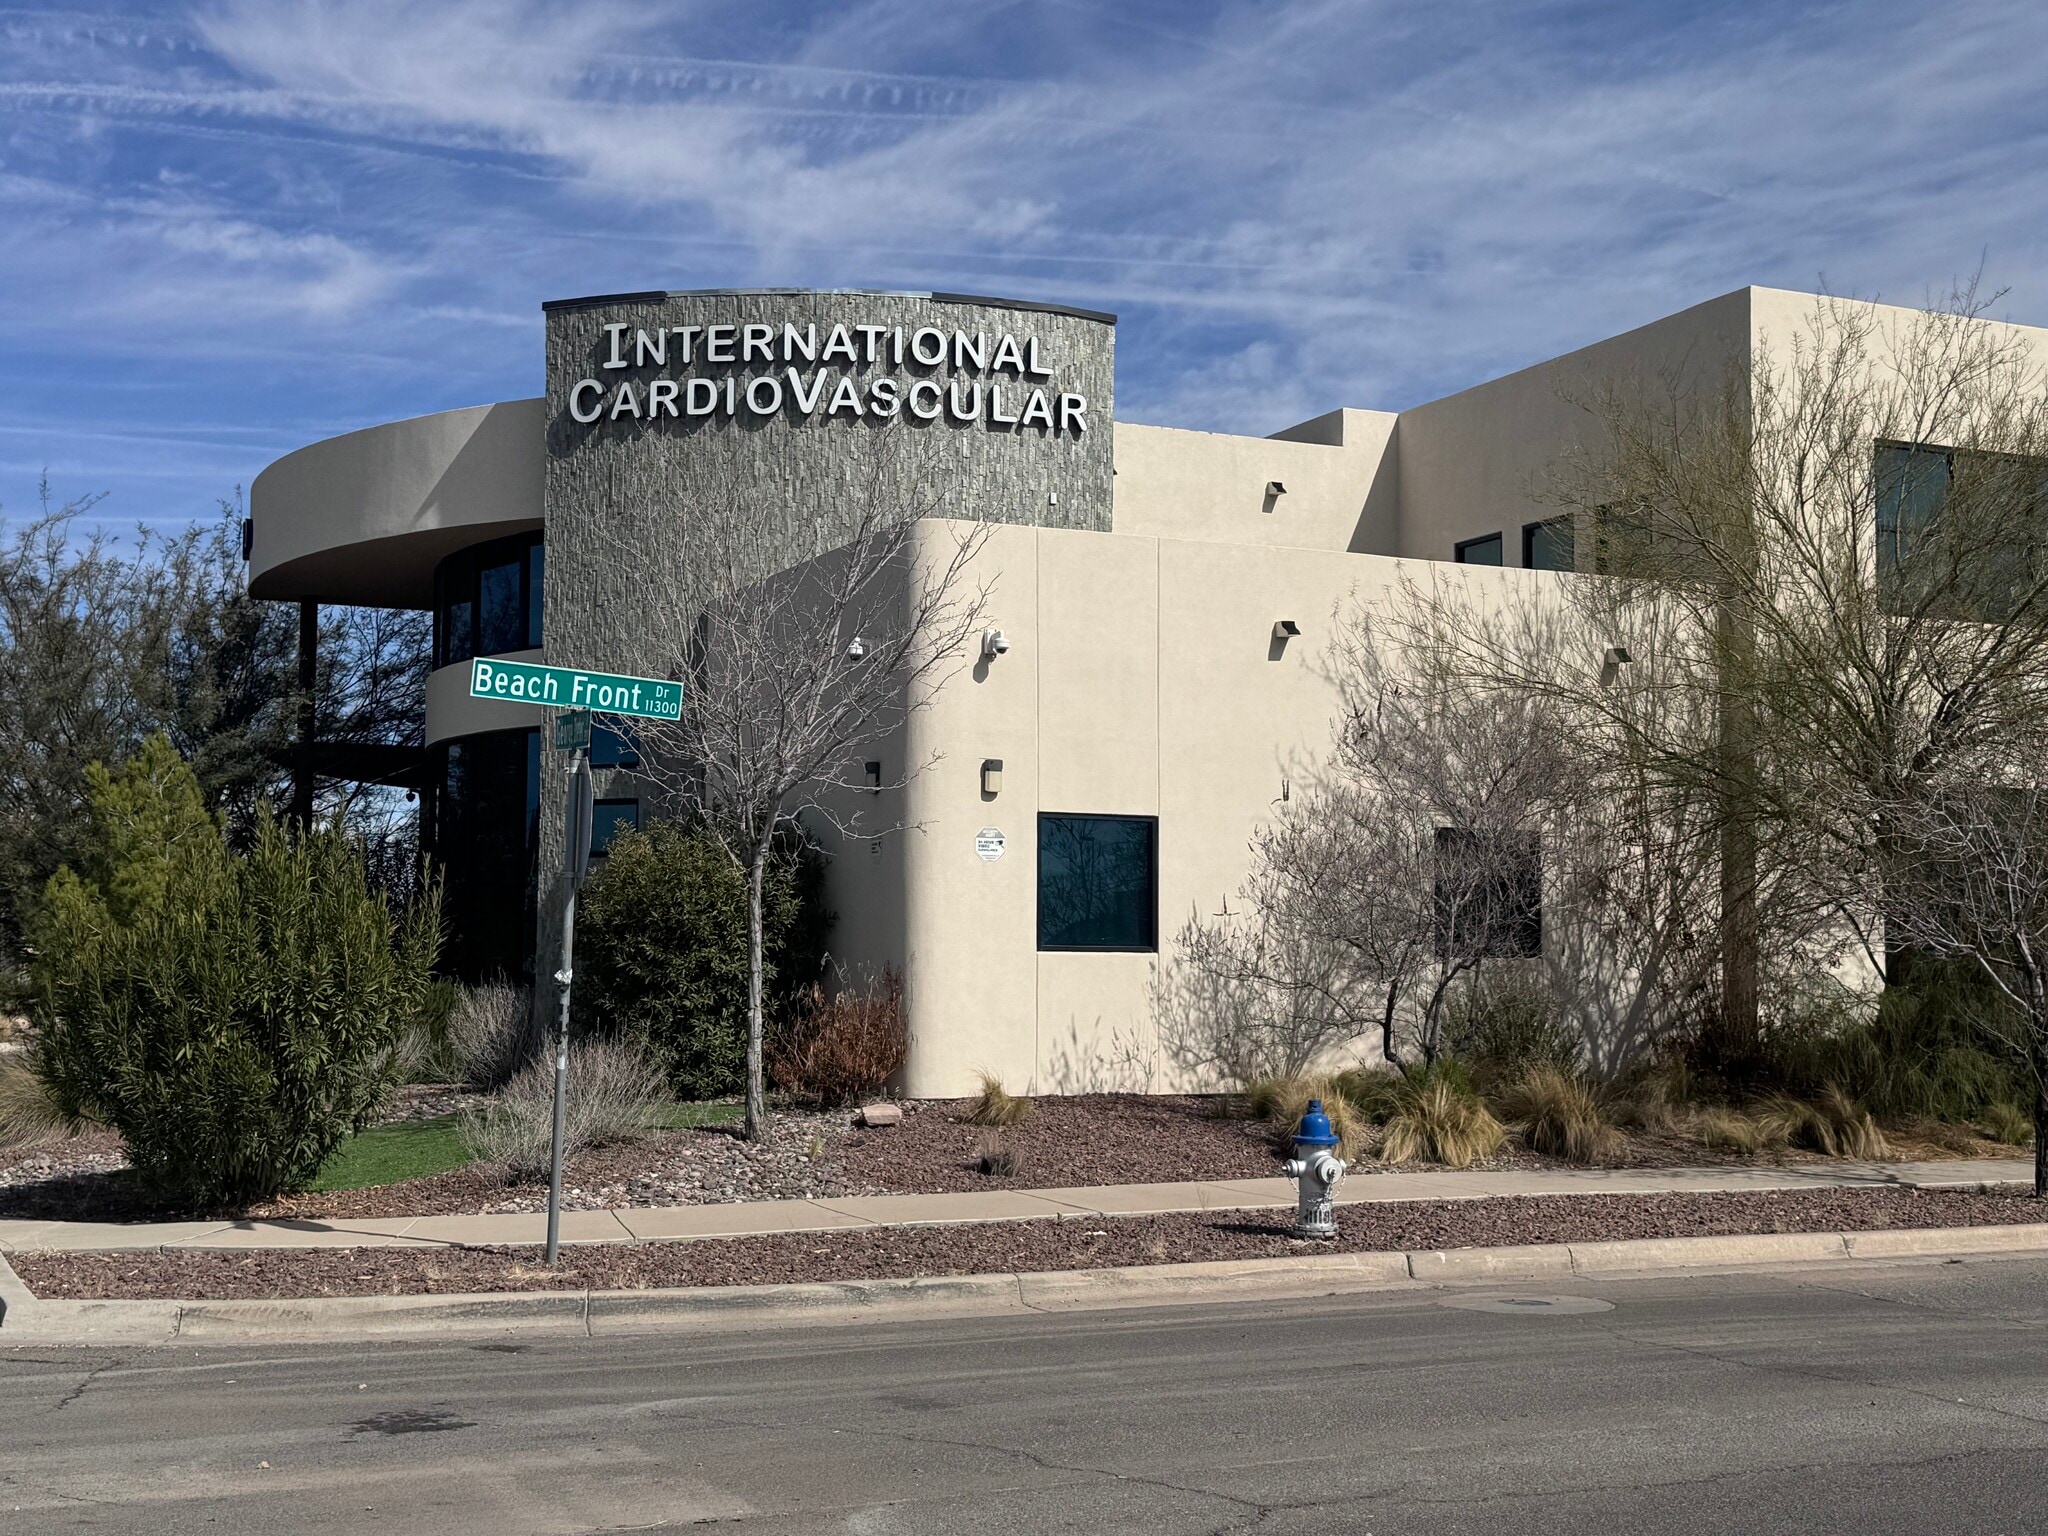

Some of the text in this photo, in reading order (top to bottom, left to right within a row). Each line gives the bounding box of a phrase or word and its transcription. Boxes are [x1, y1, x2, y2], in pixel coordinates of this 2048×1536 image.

[603, 322, 1054, 376] INTERNATIONAL
[569, 366, 1088, 431] CARDIOVASCULAR
[475, 663, 670, 710] Beach Front Dr
[644, 700, 678, 715] 11300
